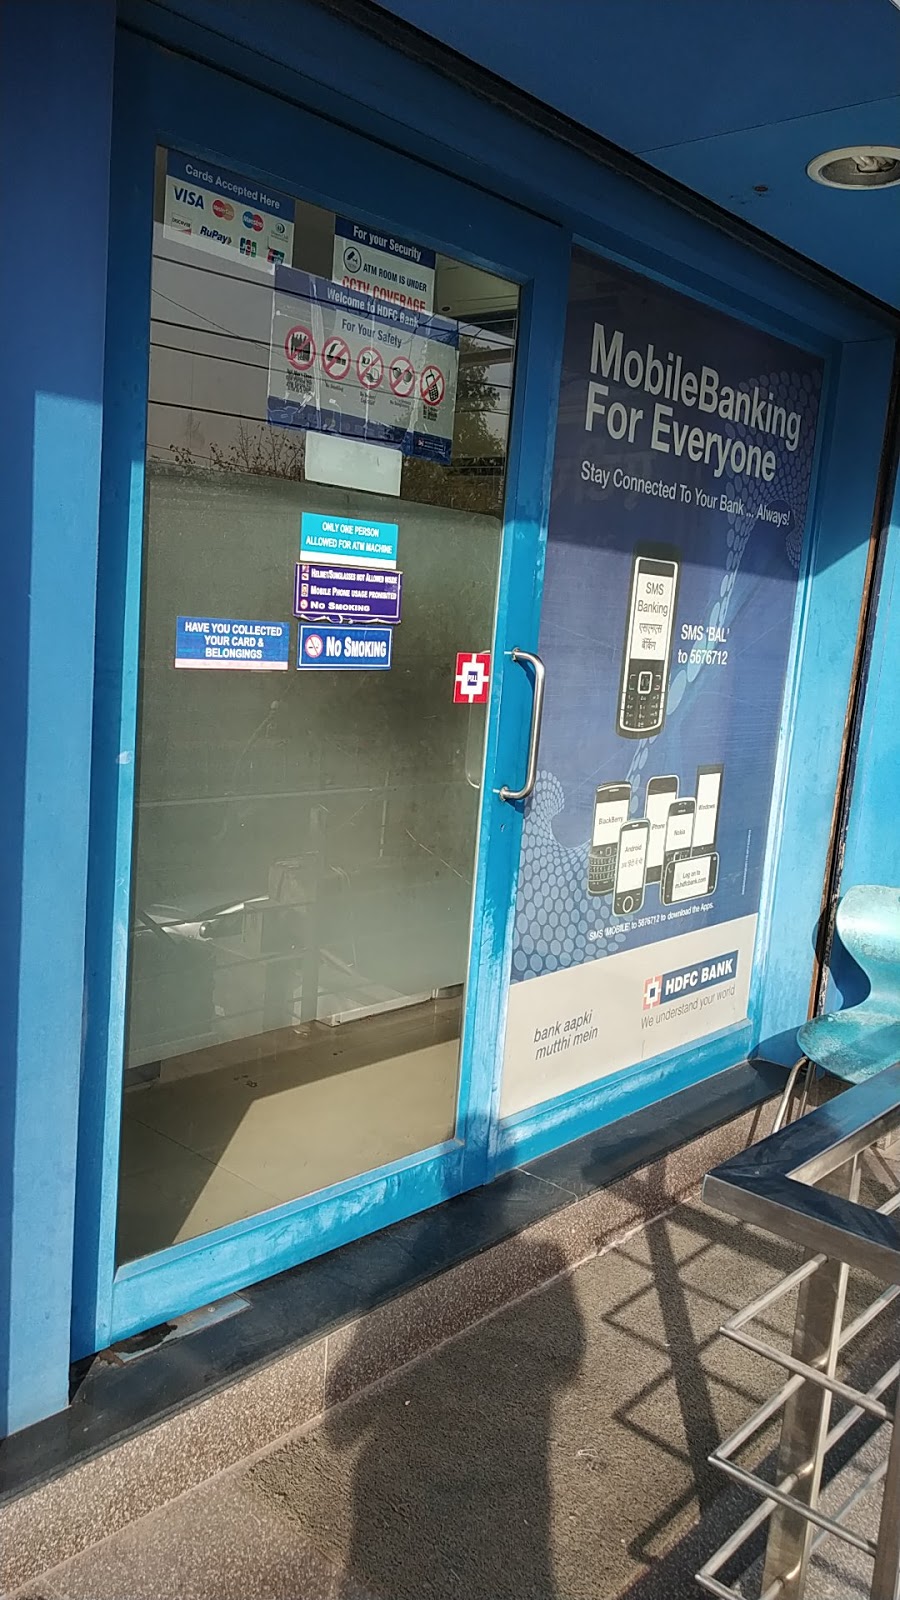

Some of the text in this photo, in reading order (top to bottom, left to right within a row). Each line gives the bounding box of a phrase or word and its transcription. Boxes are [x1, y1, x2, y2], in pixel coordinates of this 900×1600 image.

[173, 184, 205, 210] VISA
[186, 164, 281, 210] Cards Accepted Here
[200, 225, 228, 245] RuPay
[353, 225, 421, 263] For your Security
[362, 262, 427, 293] ATM ROOM IS UNDER
[326, 287, 420, 328] Welcome to HDFC Bank
[341, 318, 402, 349] For Your Safety
[589, 321, 801, 452] MobileBanking
[584, 380, 776, 482] For Everyone
[580, 460, 610, 489] Stay
[613, 468, 677, 500] Connected
[679, 483, 692, 504] To
[695, 488, 718, 509] Your
[719, 494, 745, 517] Bank
[756, 503, 791, 526] Always!
[322, 521, 379, 538] ONLY ONE PERSON
[305, 535, 393, 554] ALLOWED FOR ATM MACHINE
[645, 581, 664, 596] SMS
[637, 599, 669, 617] Banking
[184, 621, 283, 637] HAVE YOU COLLECTED
[680, 624, 704, 641] SMS
[204, 635, 264, 648] YOUR CARD &
[205, 647, 263, 659] BELONGINGS
[678, 649, 728, 665] to 5676712
[598, 815, 624, 825] BlackBerry
[651, 822, 665, 831] iPhone
[673, 828, 686, 836] Nokia
[624, 844, 642, 852] Android
[589, 929, 604, 941] SMS
[631, 921, 637, 930] to
[667, 908, 692, 920] download
[692, 905, 700, 914] the
[665, 958, 734, 996] HDFC BANK
[641, 983, 736, 1030] We understand your world
[533, 1009, 593, 1043] bank aapki
[535, 1025, 599, 1060] mutthi mein
